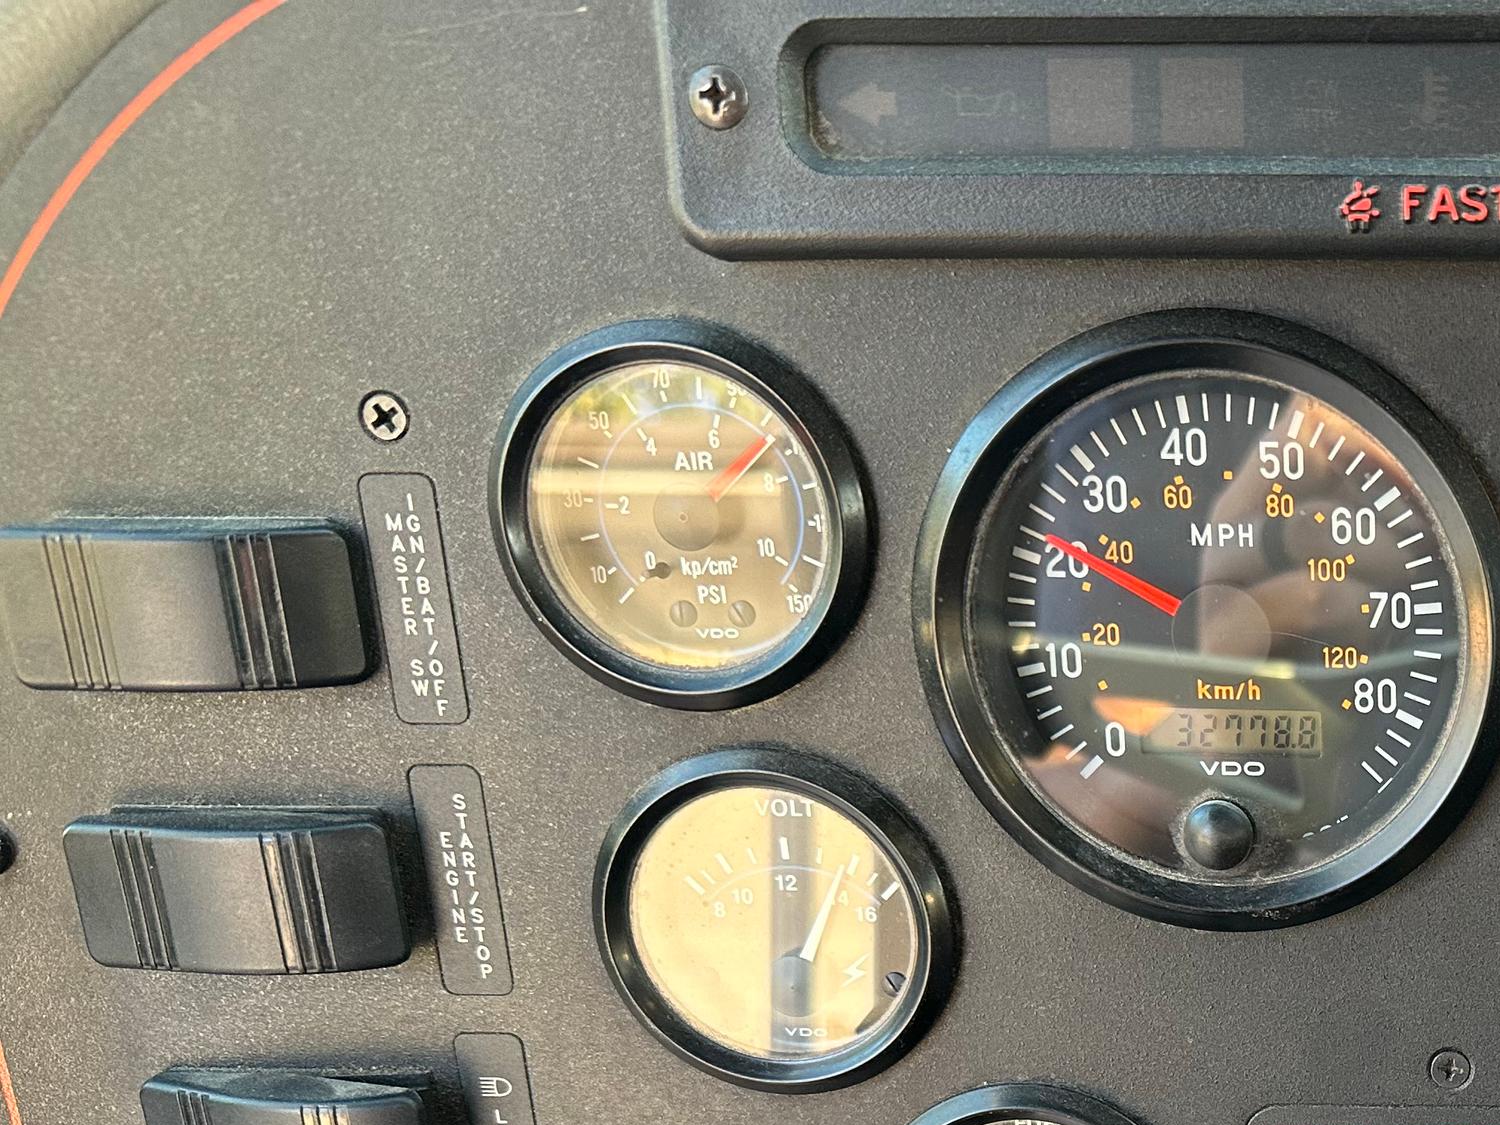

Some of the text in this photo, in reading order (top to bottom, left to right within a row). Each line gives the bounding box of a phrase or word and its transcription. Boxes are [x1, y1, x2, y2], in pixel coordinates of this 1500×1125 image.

[589, 411, 609, 430] 50
[645, 438, 657, 456] 4
[708, 430, 720, 448] 6
[1160, 428, 1208, 467] 40
[674, 451, 714, 471] AIR
[1259, 442, 1305, 480] 50
[763, 473, 775, 492] 8
[1082, 474, 1128, 513] 30
[564, 489, 583, 508] 30
[618, 496, 631, 514] 2
[1163, 486, 1193, 510] 60
[1265, 494, 1295, 518] 80
[1190, 523, 1255, 548] MPH
[1330, 507, 1377, 546] 60
[757, 538, 775, 557] 10
[1104, 541, 1134, 565] 40
[645, 551, 656, 570] 0
[1045, 541, 1089, 579] 20
[1307, 558, 1347, 582] 100
[591, 565, 607, 584] 10
[385, 513, 430, 697] MASTER SW
[697, 585, 728, 605] PSI
[1368, 592, 1412, 629] 70
[696, 628, 740, 639] VDO
[1093, 623, 1121, 646] 20
[1045, 643, 1083, 678] 10
[1322, 646, 1358, 669] 120
[1196, 679, 1262, 701] km/h
[1354, 678, 1398, 714] 80
[1105, 723, 1127, 757] 0
[1200, 761, 1266, 777] VDO
[754, 798, 816, 818] VOLT
[439, 831, 469, 943] ENGINE
[452, 793, 493, 979] START/STOP
[774, 874, 799, 892] 12
[731, 887, 754, 905] 10
[713, 901, 727, 918] 8
[855, 906, 878, 923] 16
[784, 1026, 828, 1038] VDO
